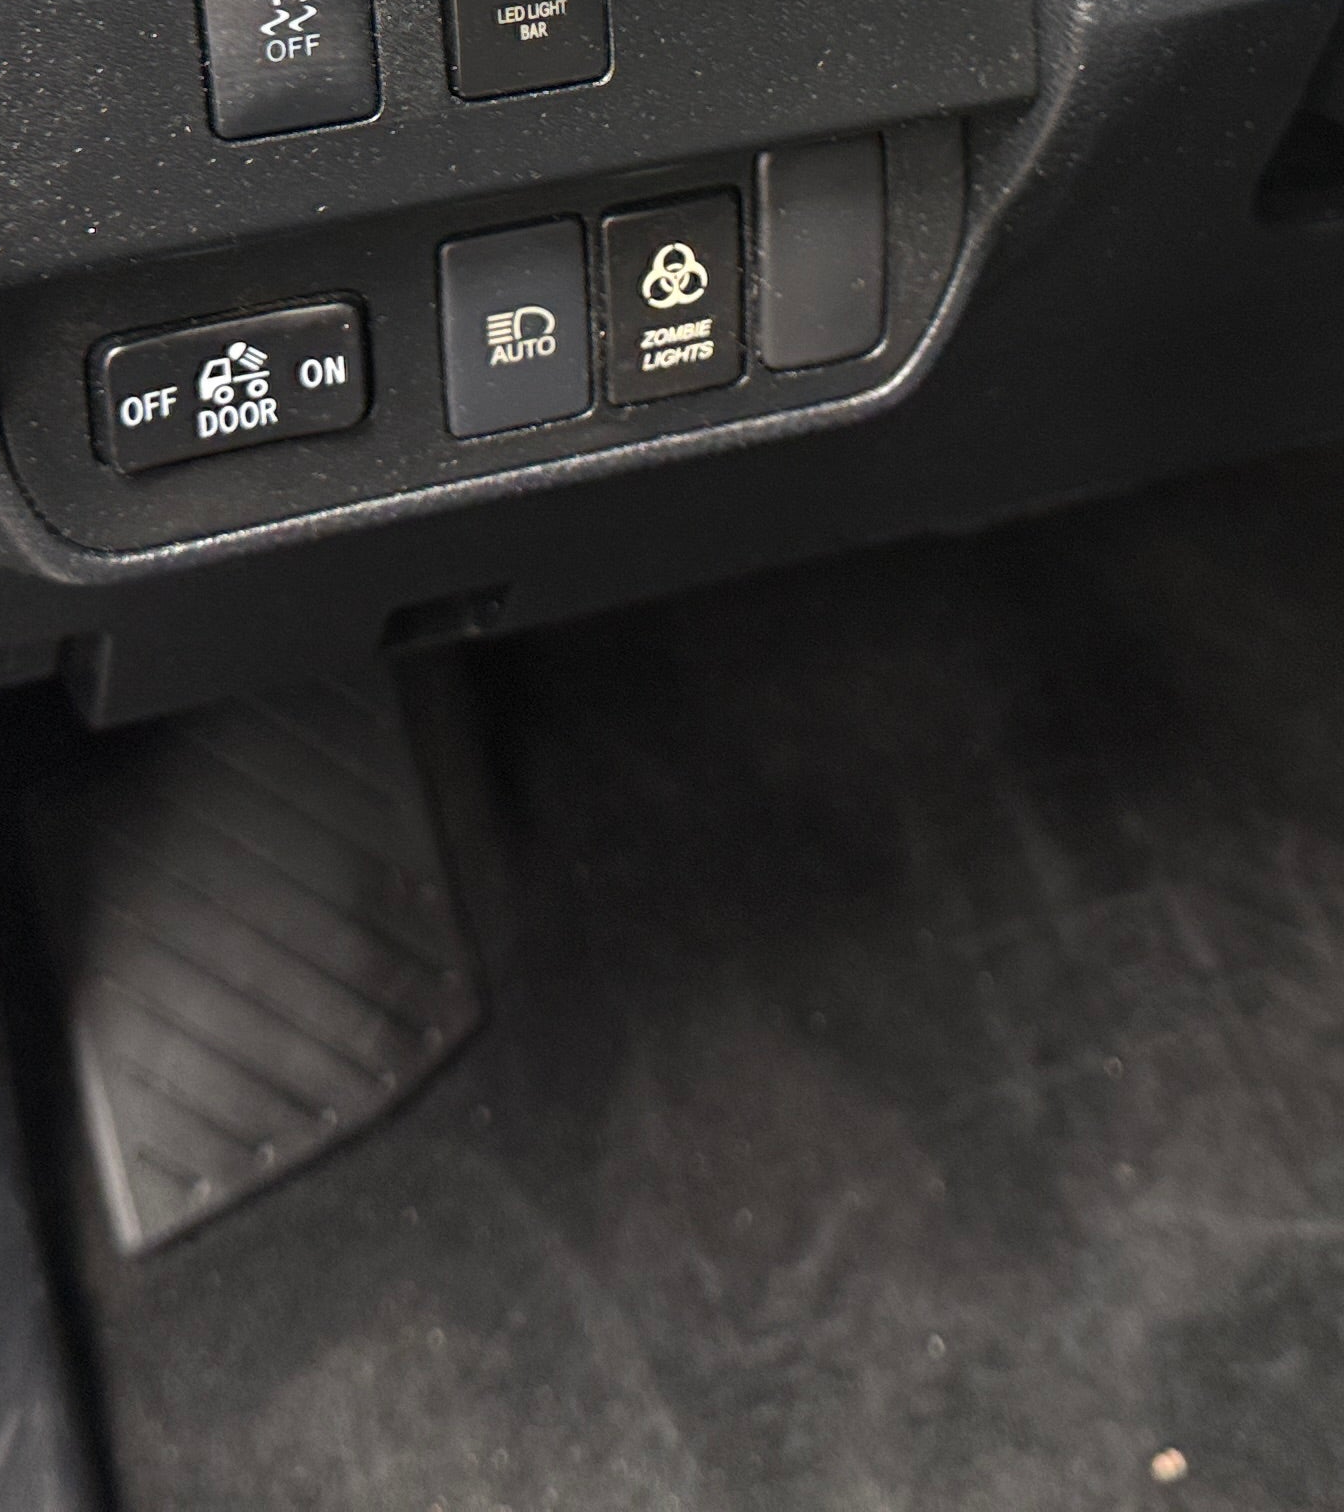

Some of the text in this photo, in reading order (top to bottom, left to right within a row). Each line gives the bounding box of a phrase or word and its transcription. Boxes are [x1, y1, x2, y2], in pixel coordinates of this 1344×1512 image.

[497, 5, 525, 25] LED
[520, 21, 548, 41] BAR
[266, 33, 320, 63] OFF
[640, 318, 713, 350] ZOMBIE
[490, 336, 556, 366] AUTO
[641, 340, 715, 372] LIGHTS
[298, 355, 347, 389] ON
[120, 386, 177, 427] OFF
[197, 397, 279, 439] DOOR
